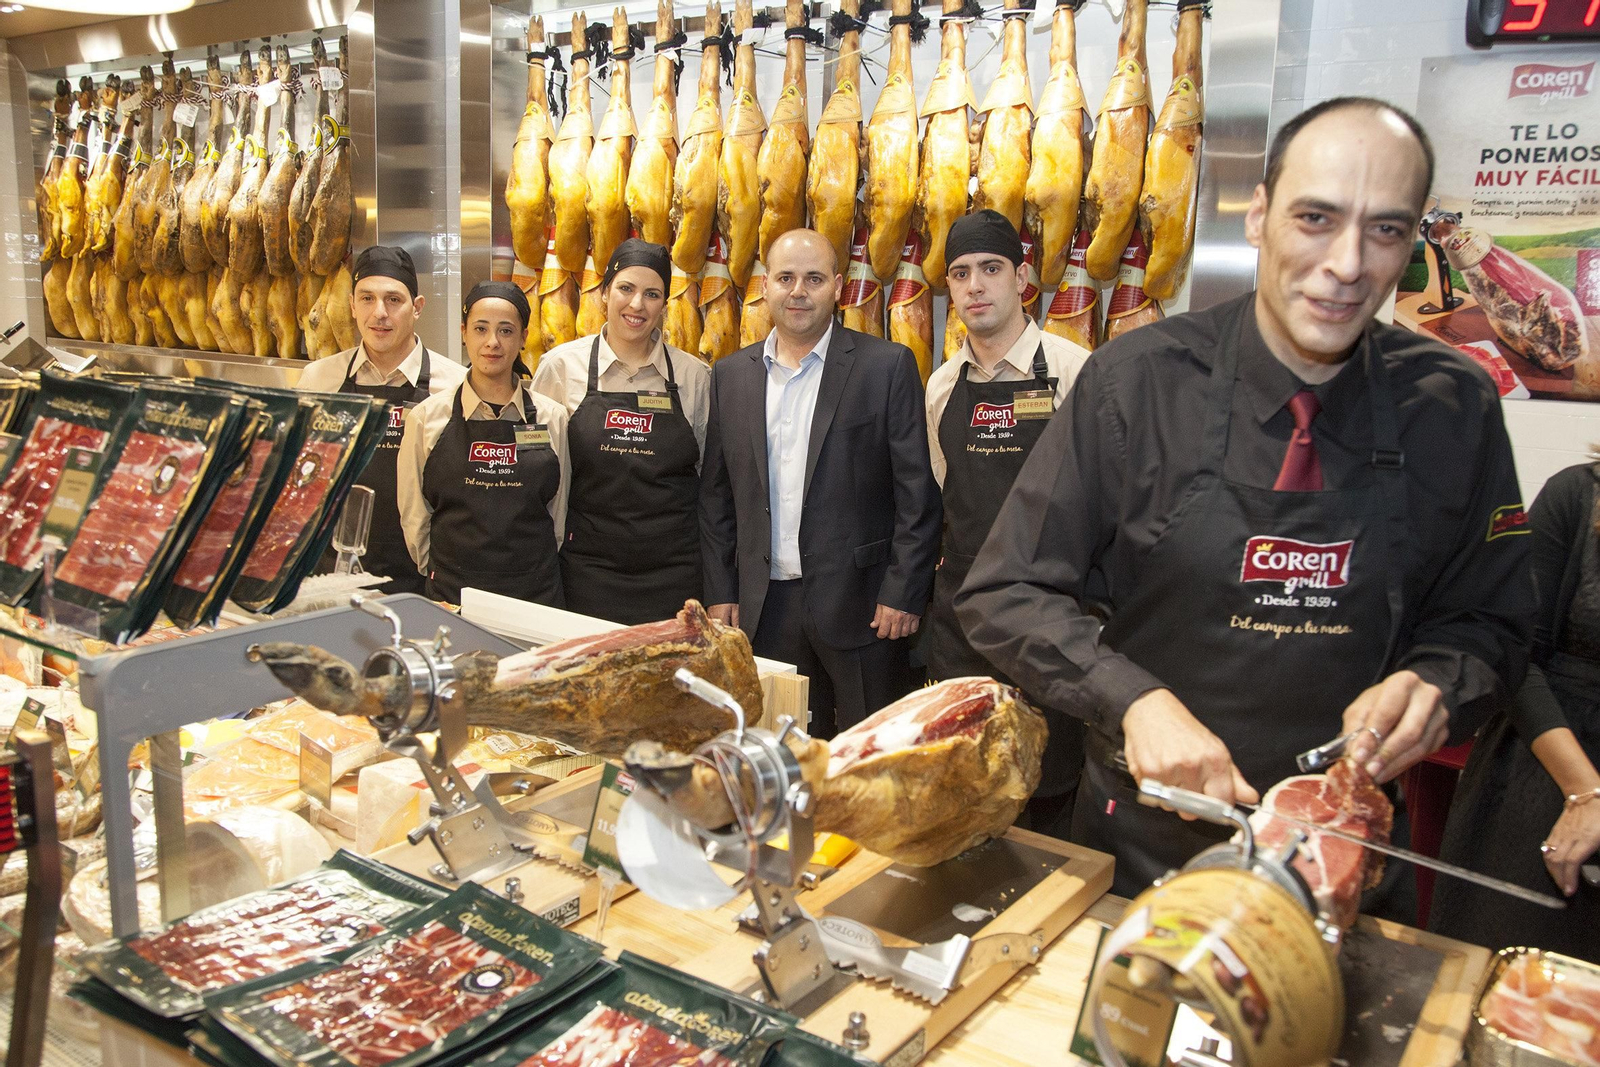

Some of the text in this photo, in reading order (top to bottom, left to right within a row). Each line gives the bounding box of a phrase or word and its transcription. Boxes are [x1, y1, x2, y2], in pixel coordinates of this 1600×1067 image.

[1540, 86, 1576, 106] grill
[1511, 123, 1578, 141] TE LO
[1480, 145, 1600, 164] PONEMOS
[1474, 165, 1600, 187] MUY FÁCIL
[1017, 401, 1048, 409] ESTEBAN
[623, 425, 643, 435] grill
[988, 419, 1009, 432] grill
[488, 457, 509, 468] grill
[479, 467, 496, 475] Desde
[1284, 571, 1329, 595] grill
[1262, 594, 1300, 607] Desde
